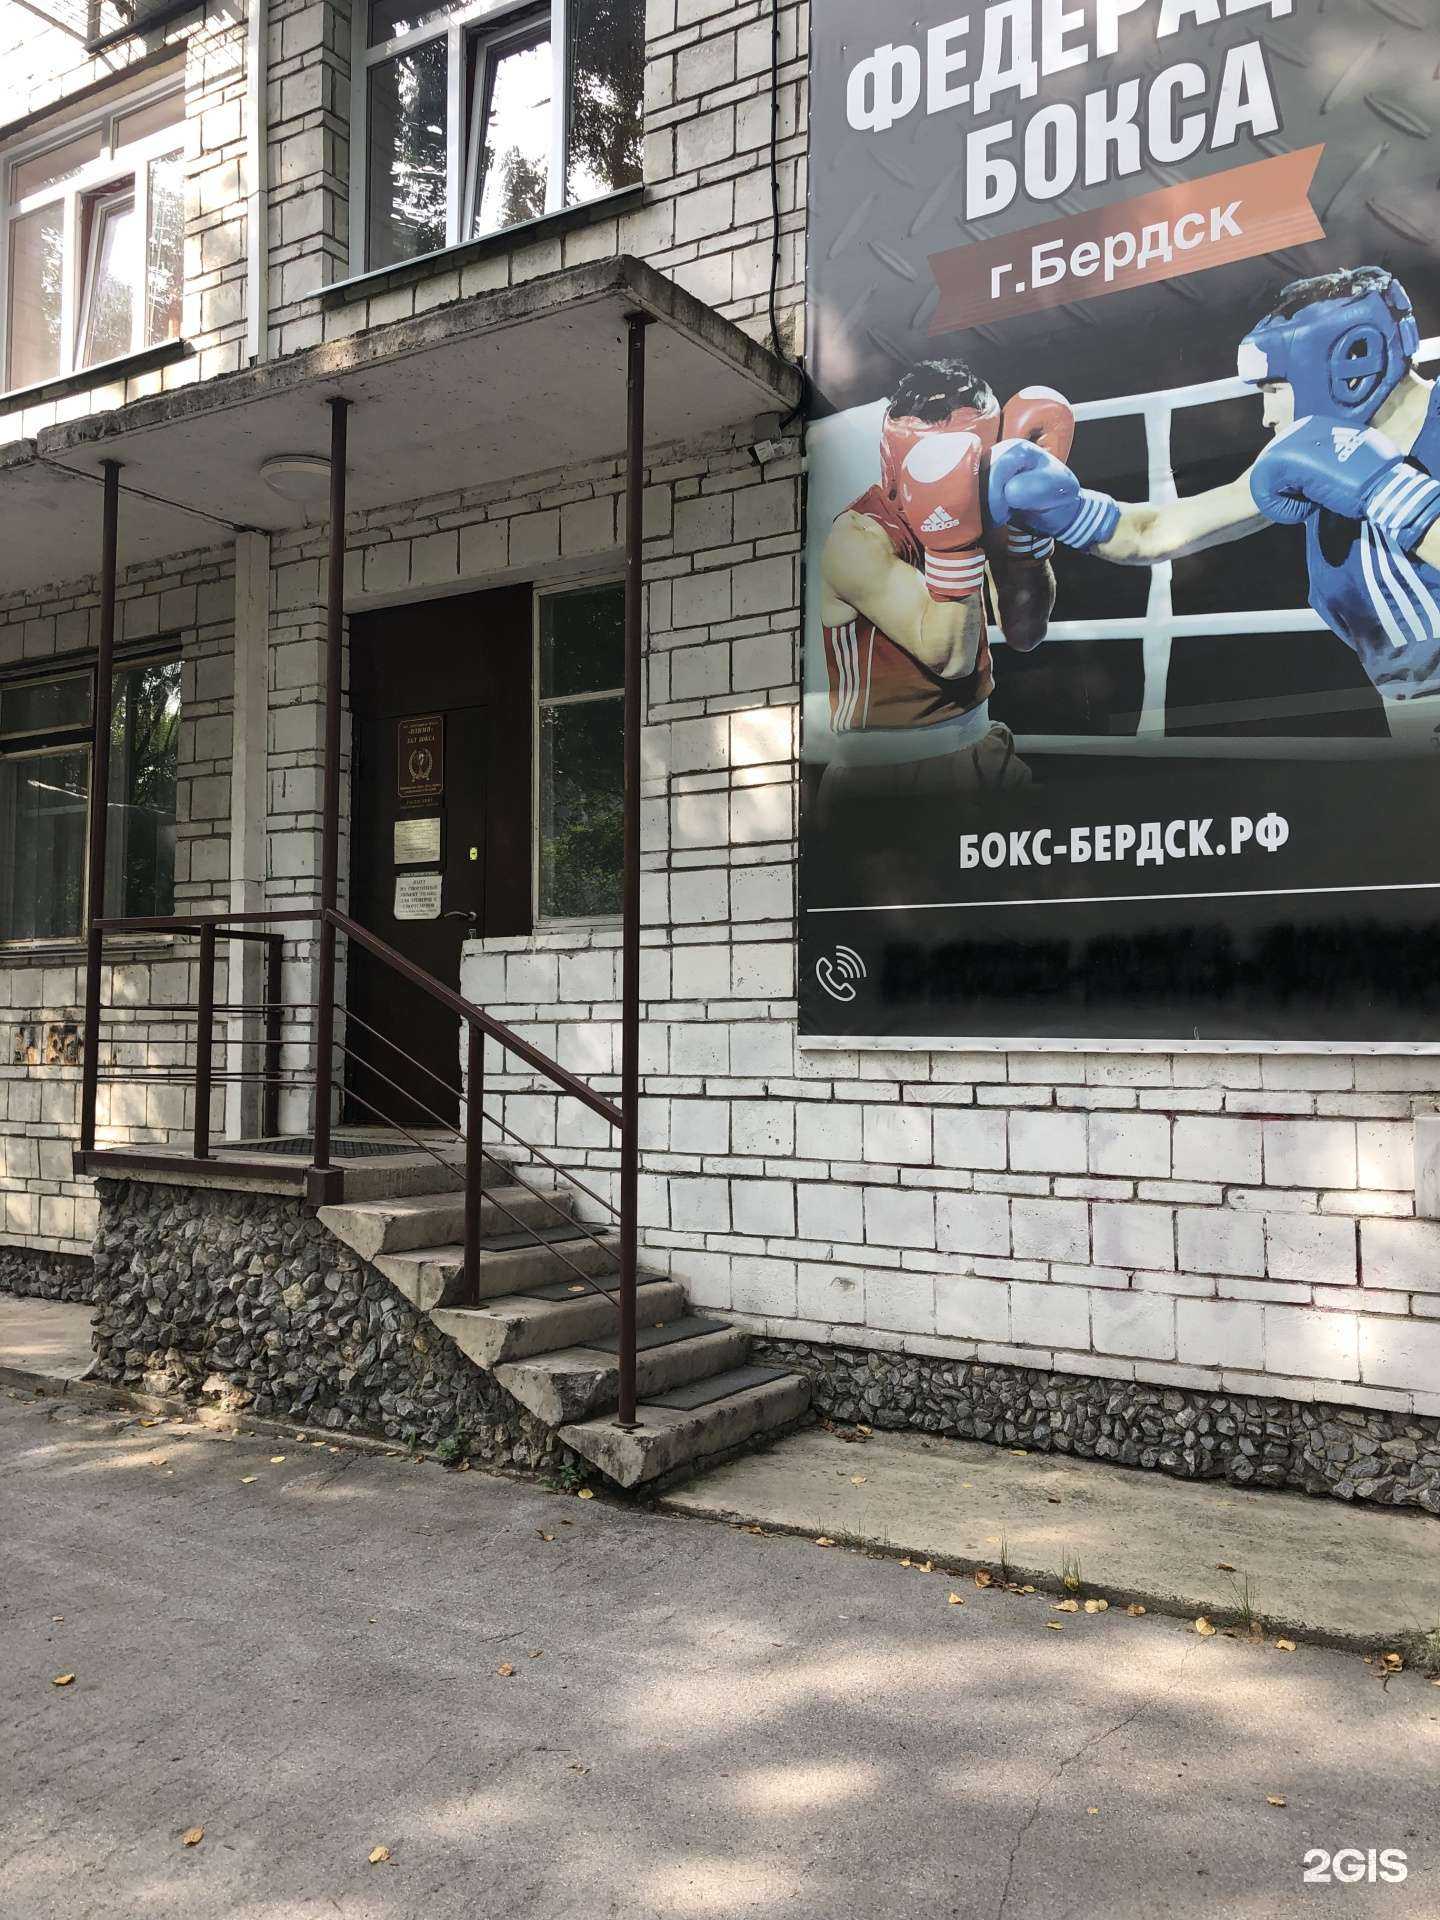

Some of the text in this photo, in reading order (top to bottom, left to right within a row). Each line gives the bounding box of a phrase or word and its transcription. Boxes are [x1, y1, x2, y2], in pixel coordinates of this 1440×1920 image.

[846, 0, 1292, 133] ФЕДЕР
[966, 40, 1280, 221] БОКСА
[990, 200, 1244, 299] г.Бердск
[959, 812, 1290, 869] БОКС-БЕРДСК.РФ
